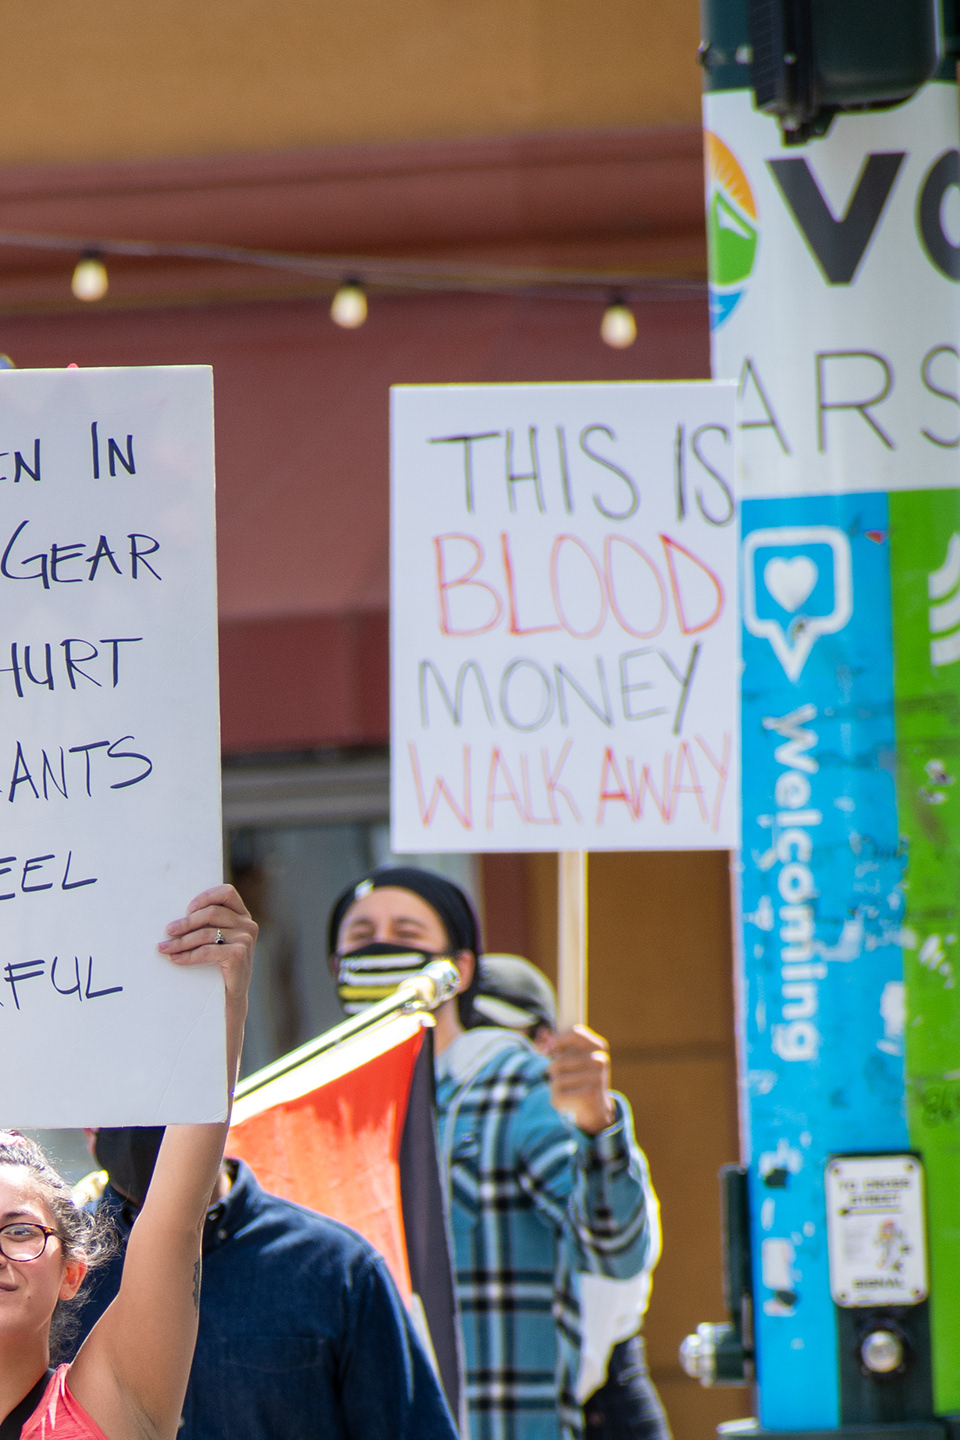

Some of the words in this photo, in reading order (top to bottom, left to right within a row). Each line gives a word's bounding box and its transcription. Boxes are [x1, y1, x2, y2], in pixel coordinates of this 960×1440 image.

[91, 421, 136, 479] IN
[427, 423, 640, 521] THIS
[674, 422, 736, 527] IS
[0, 520, 162, 590] GEAR
[433, 532, 725, 640] BLOOD
[418, 641, 702, 735] MONEY
[409, 738, 581, 830] WALK
[597, 732, 733, 833] AWAY
[771, 703, 828, 1062] Welcoming
